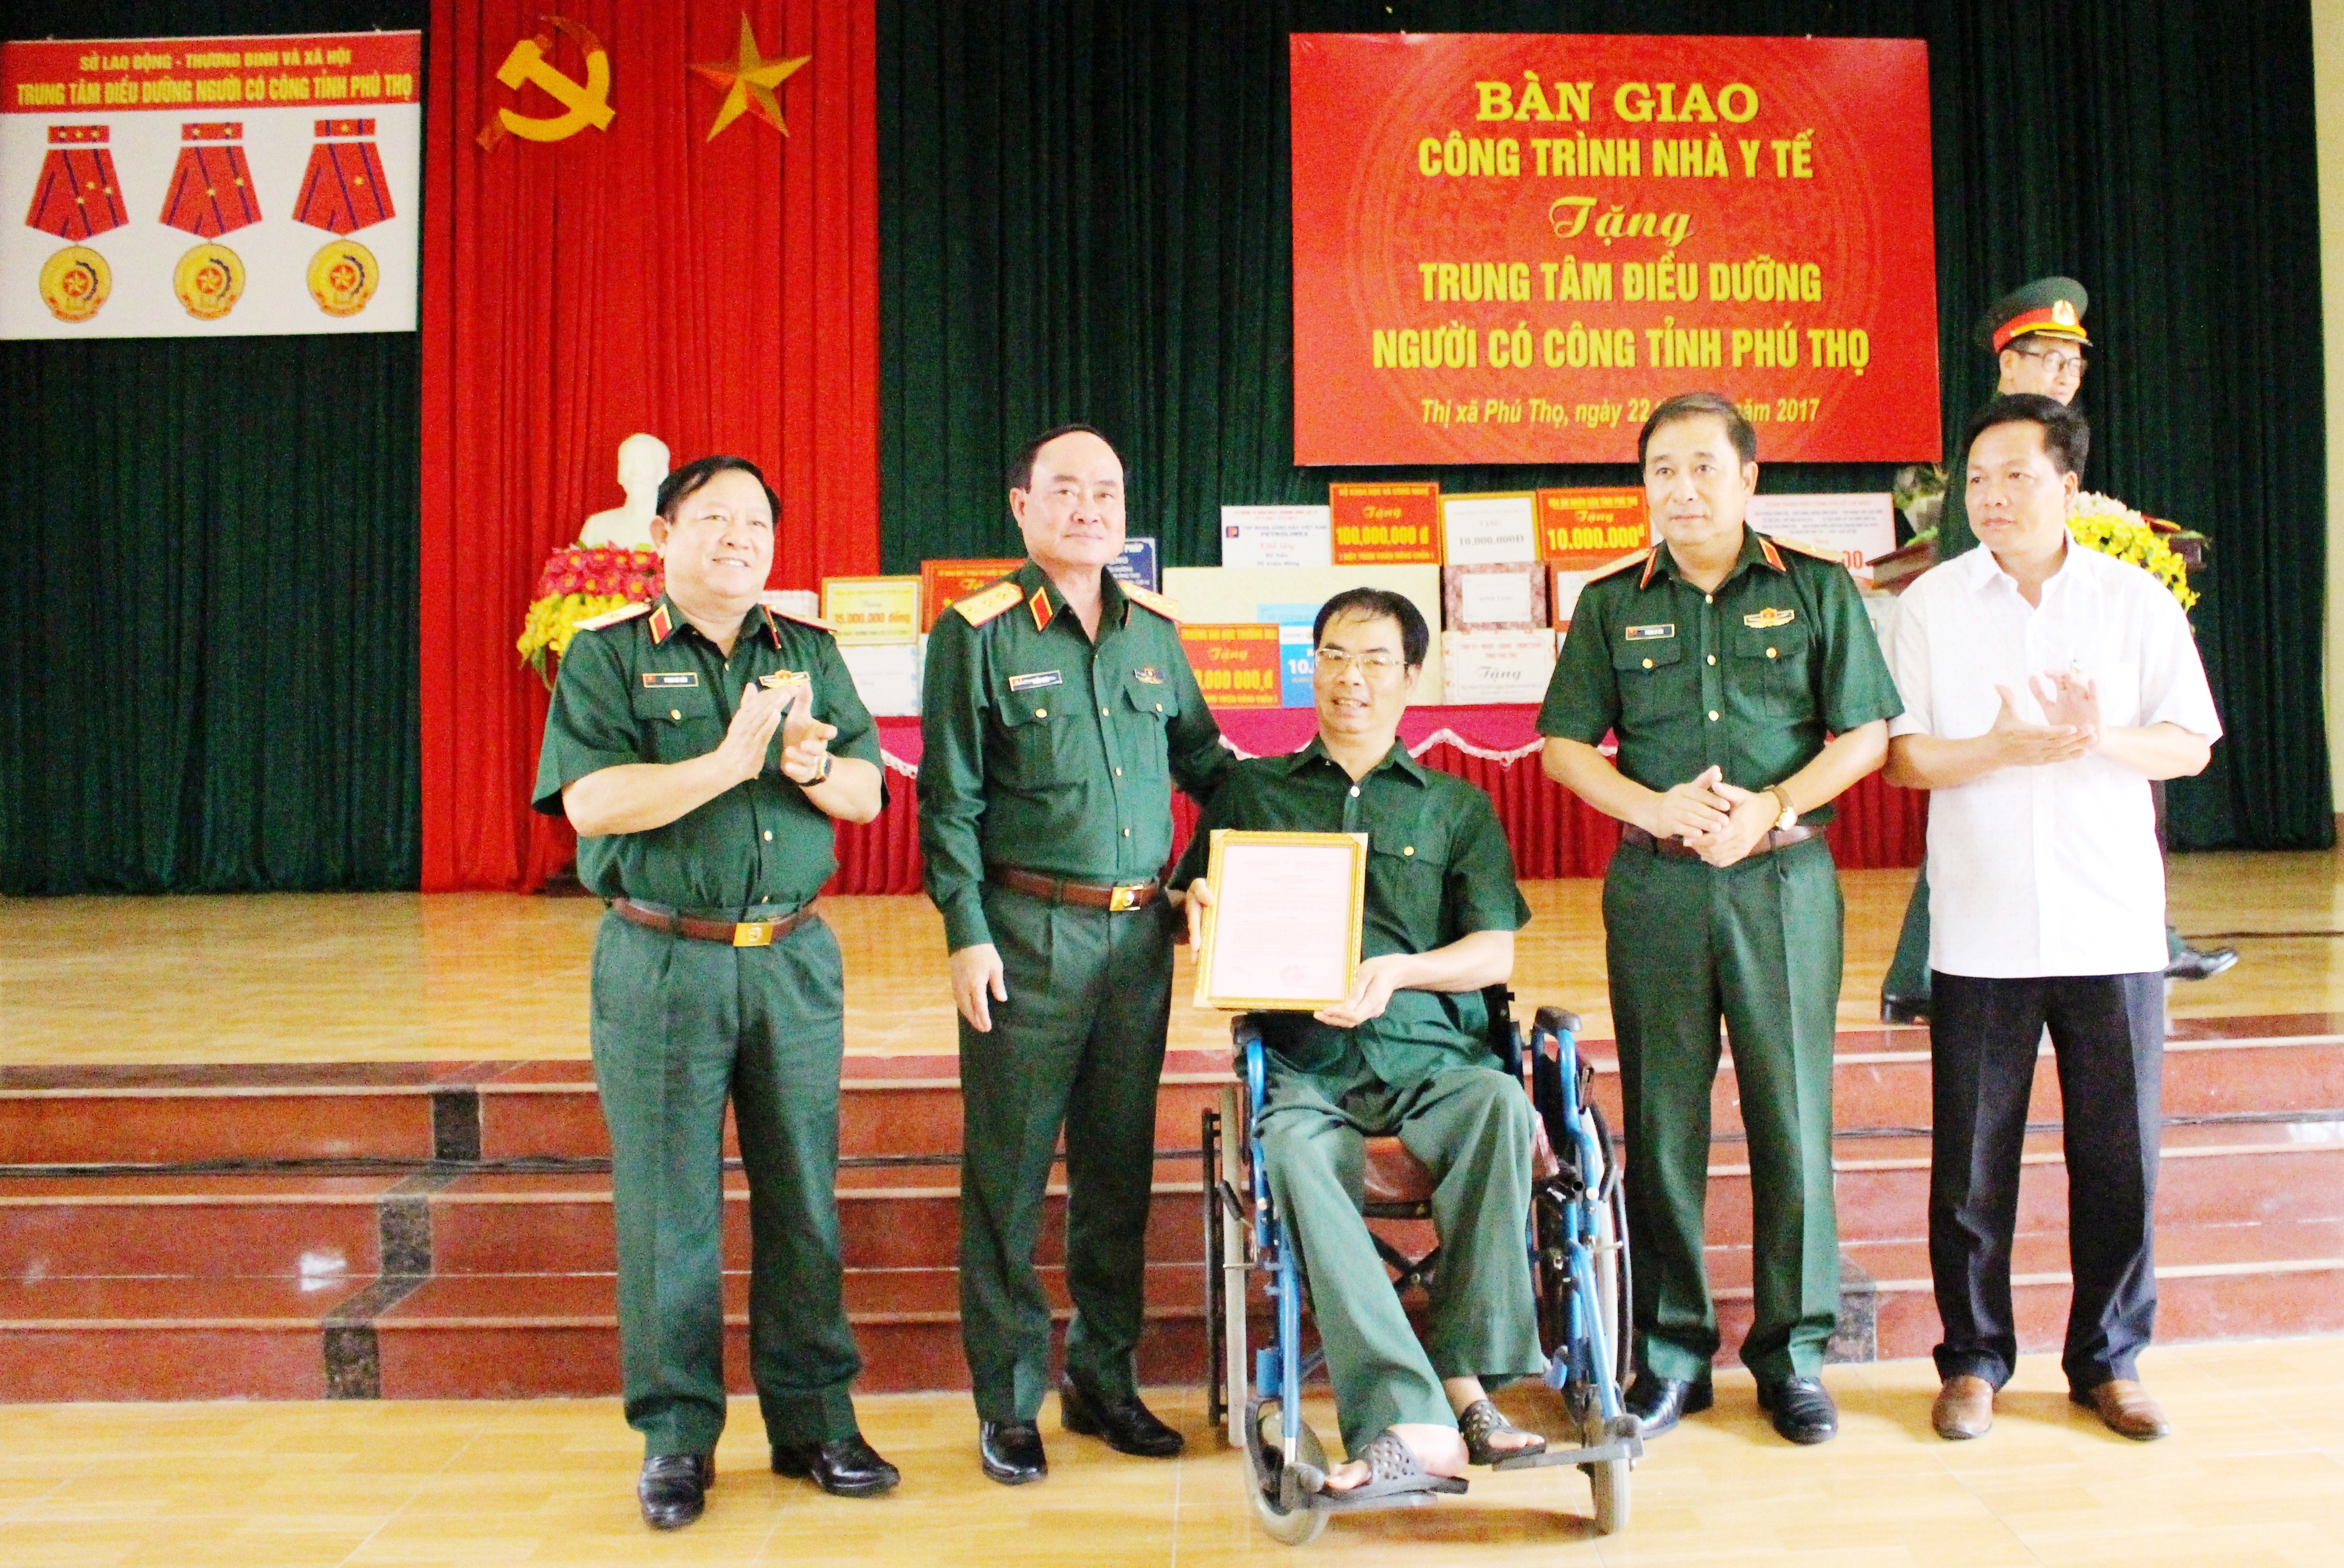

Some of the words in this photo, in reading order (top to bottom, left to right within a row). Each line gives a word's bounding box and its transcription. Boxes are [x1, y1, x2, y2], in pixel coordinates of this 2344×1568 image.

[103, 55, 129, 70] LAO
[282, 48, 301, 65] VÀ
[18, 83, 65, 105] TRUNG
[70, 79, 101, 104] TÂM
[245, 74, 265, 101] CÓ
[269, 73, 310, 100] CÔNG
[350, 69, 380, 98] PHÚ
[384, 73, 412, 101] THỌ
[1475, 70, 1593, 122] BÀN
[1614, 82, 1758, 123] GIAO
[1419, 130, 1520, 177] CÔNG
[1531, 131, 1640, 177] TRÌNH
[1653, 132, 1728, 177] NHÀ
[1739, 140, 1759, 178] Y
[1771, 128, 1814, 178] TẾ
[1549, 196, 1692, 246] Tặng
[1419, 262, 1530, 302] TRUNG
[1539, 254, 1613, 302] TÂM
[1622, 249, 1698, 303] ĐIỀU
[1709, 255, 1822, 303] DƯỠNG
[1373, 320, 1477, 368] NGƯỜI
[1489, 320, 1533, 368] CÓ
[1544, 320, 1636, 368] CÔNG
[1645, 315, 1722, 368] TỈNH
[1731, 320, 1798, 368] PHÚ
[1807, 329, 1870, 376] THỌ
[1421, 399, 1452, 428] Thị
[1456, 399, 1479, 423] xã
[1484, 398, 1522, 423] Phú
[1529, 398, 1569, 428] Thọ,
[1575, 398, 1623, 428] ngày
[1628, 398, 1650, 422] 22
[1776, 398, 1820, 422] 2017
[1364, 506, 1402, 519] Tặng
[1575, 510, 1614, 523] Tặng
[1478, 667, 1521, 682] Tặng
